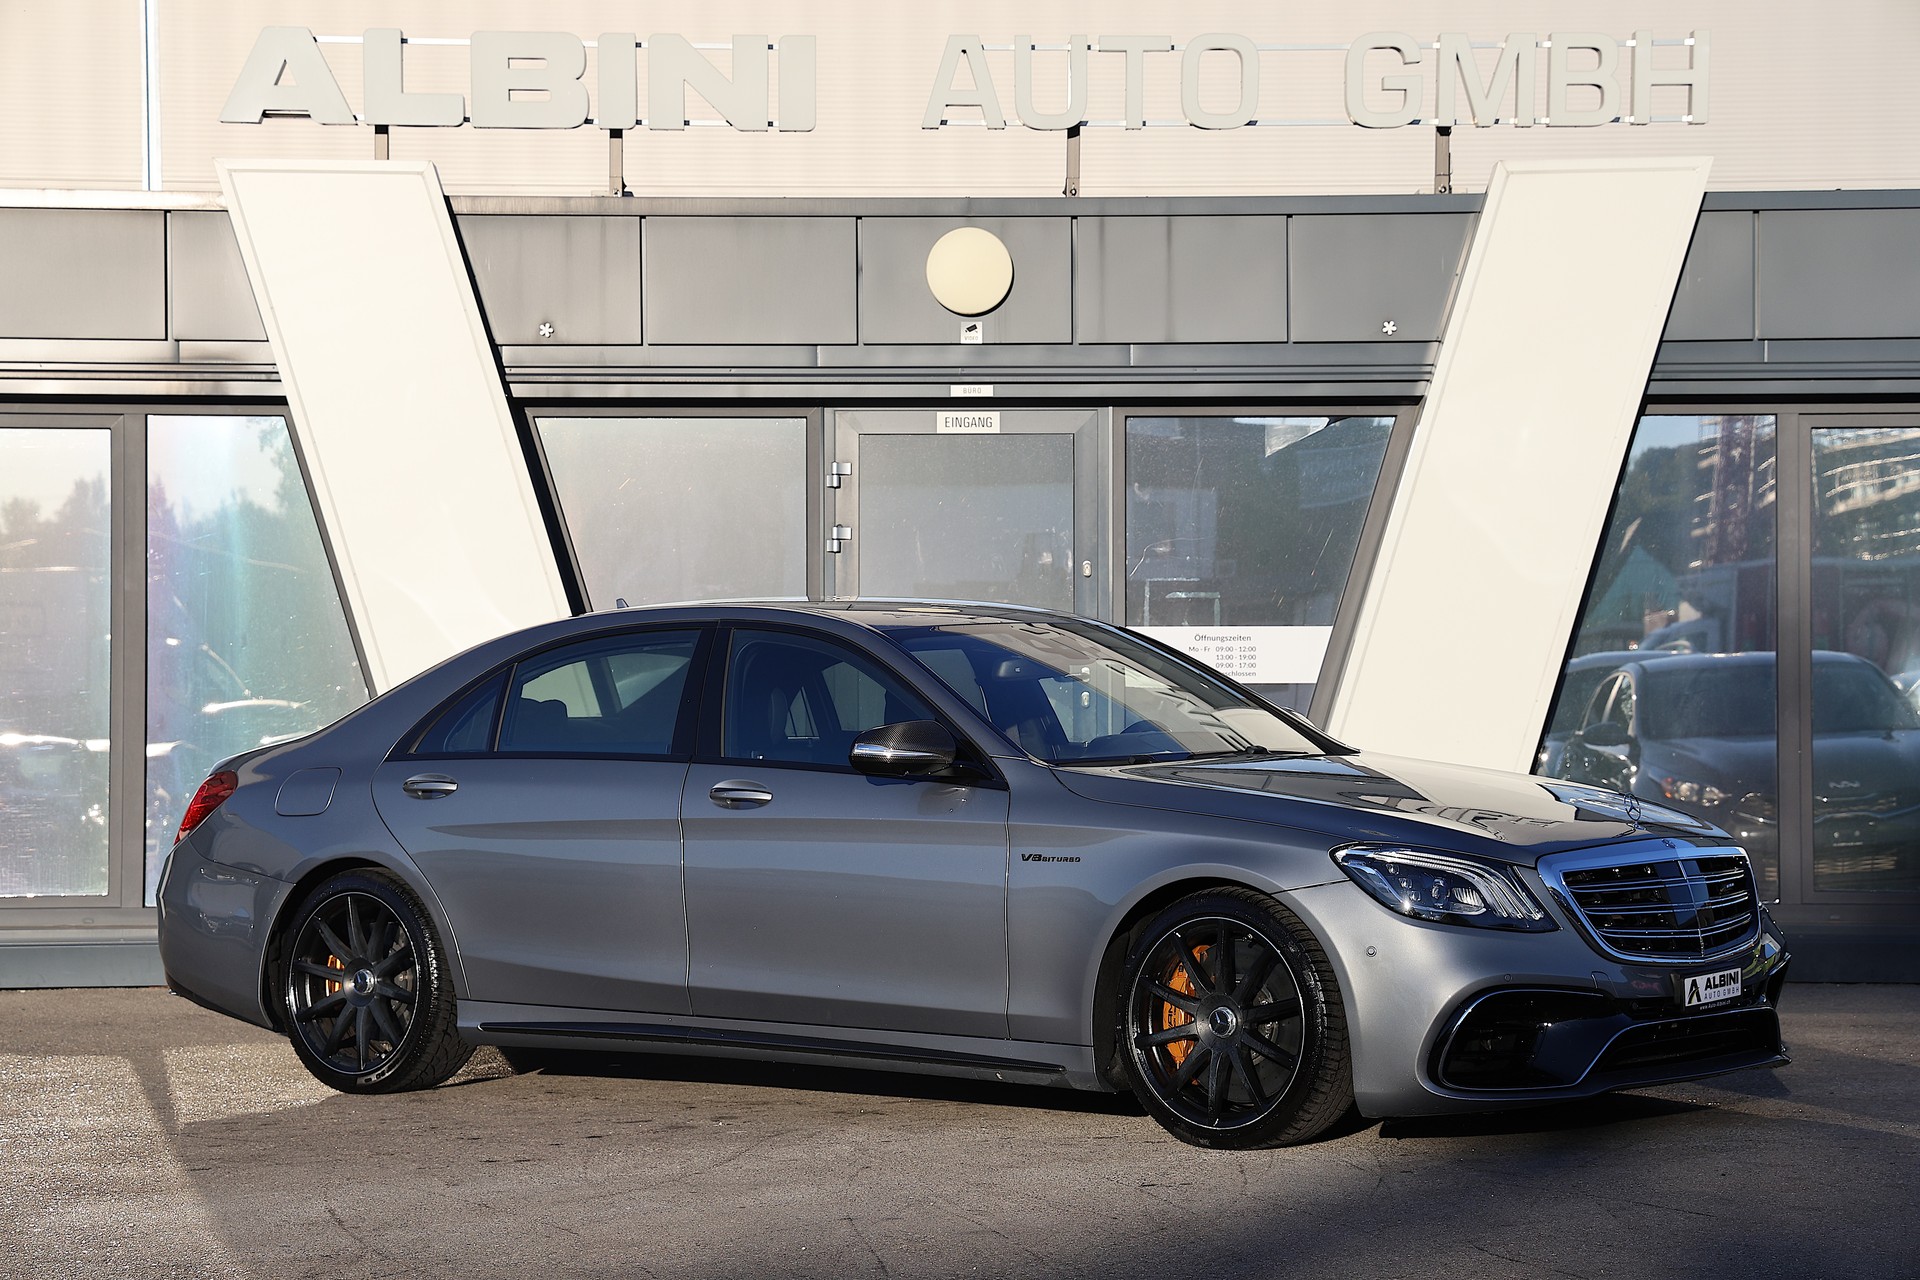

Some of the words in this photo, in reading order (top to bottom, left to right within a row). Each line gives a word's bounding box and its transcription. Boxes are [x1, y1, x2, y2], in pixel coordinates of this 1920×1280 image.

[219, 25, 817, 133] ALBINI
[921, 32, 1260, 131] AUTO
[1344, 29, 1712, 129] GMBH
[962, 386, 982, 394] BÜRO
[944, 416, 993, 428] EINGANG
[1194, 633, 1252, 643] Öffnungszeiten
[1704, 970, 1739, 992] ALBINI
[1704, 990, 1721, 1000] AUTO
[1723, 986, 1740, 996] GMBH
